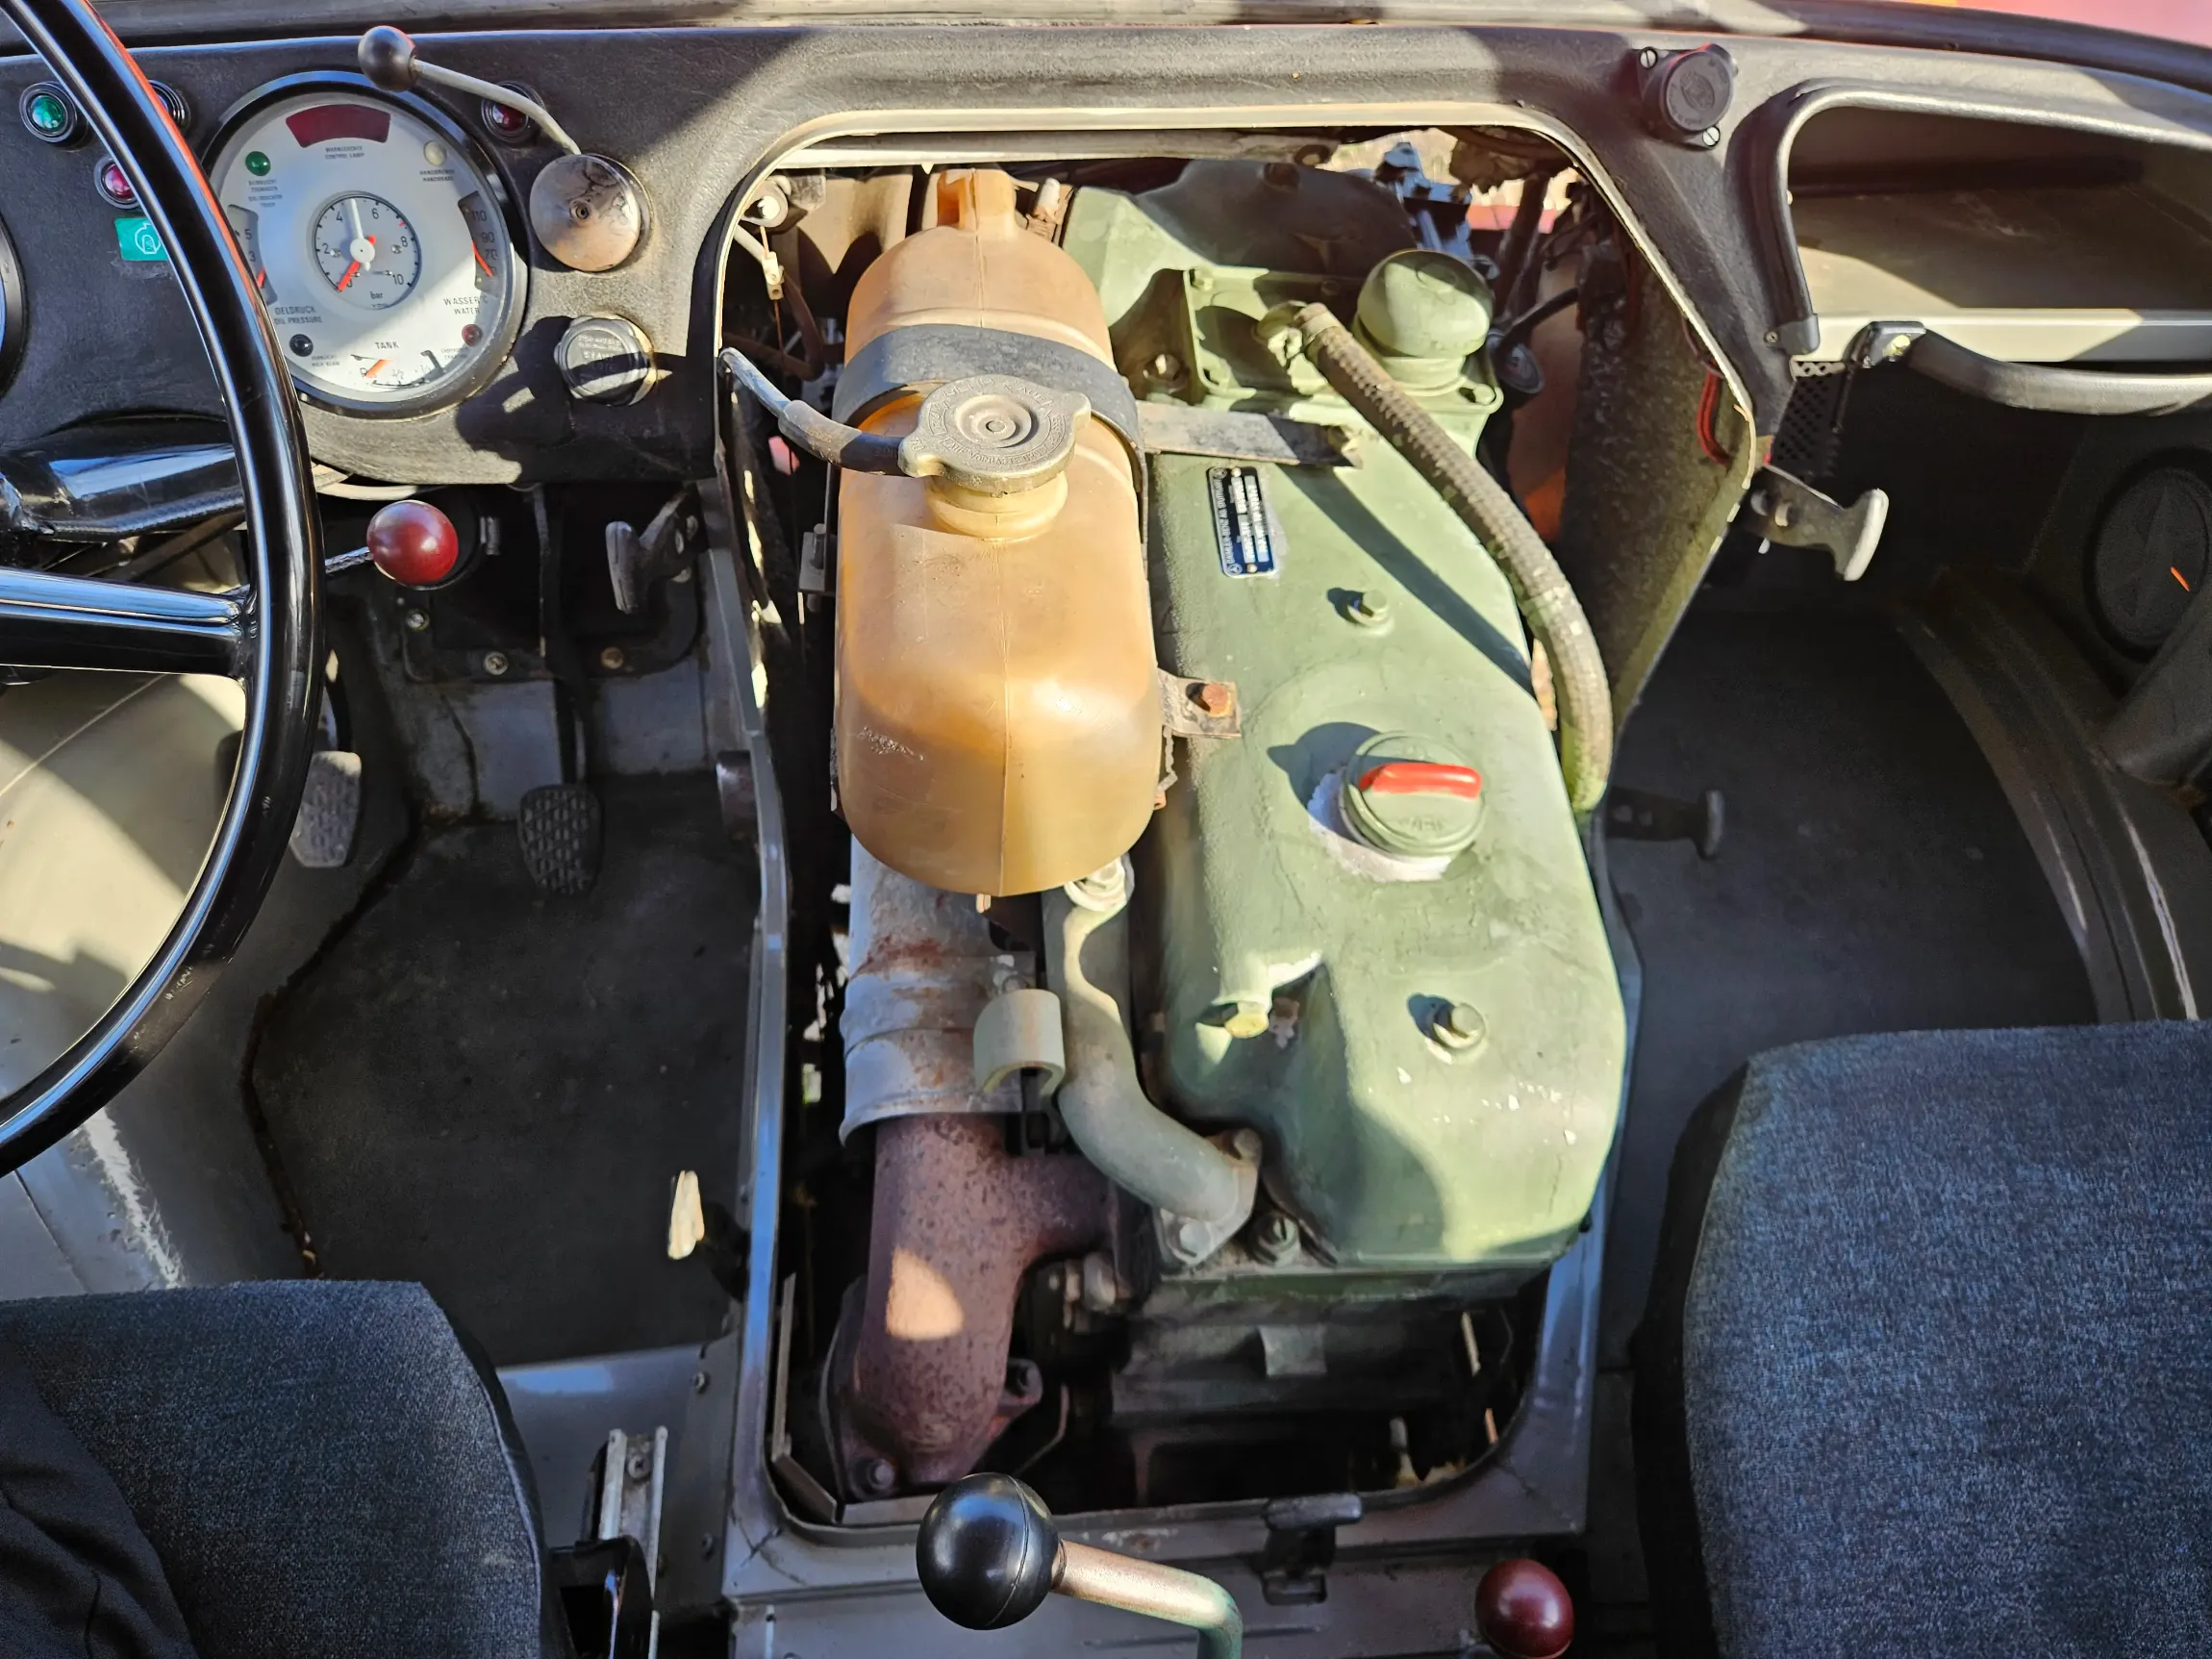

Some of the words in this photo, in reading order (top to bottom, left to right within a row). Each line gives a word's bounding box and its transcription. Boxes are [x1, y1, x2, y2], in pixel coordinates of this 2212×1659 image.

[336, 211, 343, 222] 4
[371, 208, 379, 219] 6
[244, 229, 252, 239] 5
[400, 237, 408, 247] 8
[322, 243, 330, 255] 2
[248, 251, 256, 262] 3
[392, 274, 404, 285] 10
[374, 341, 399, 350] TANK
